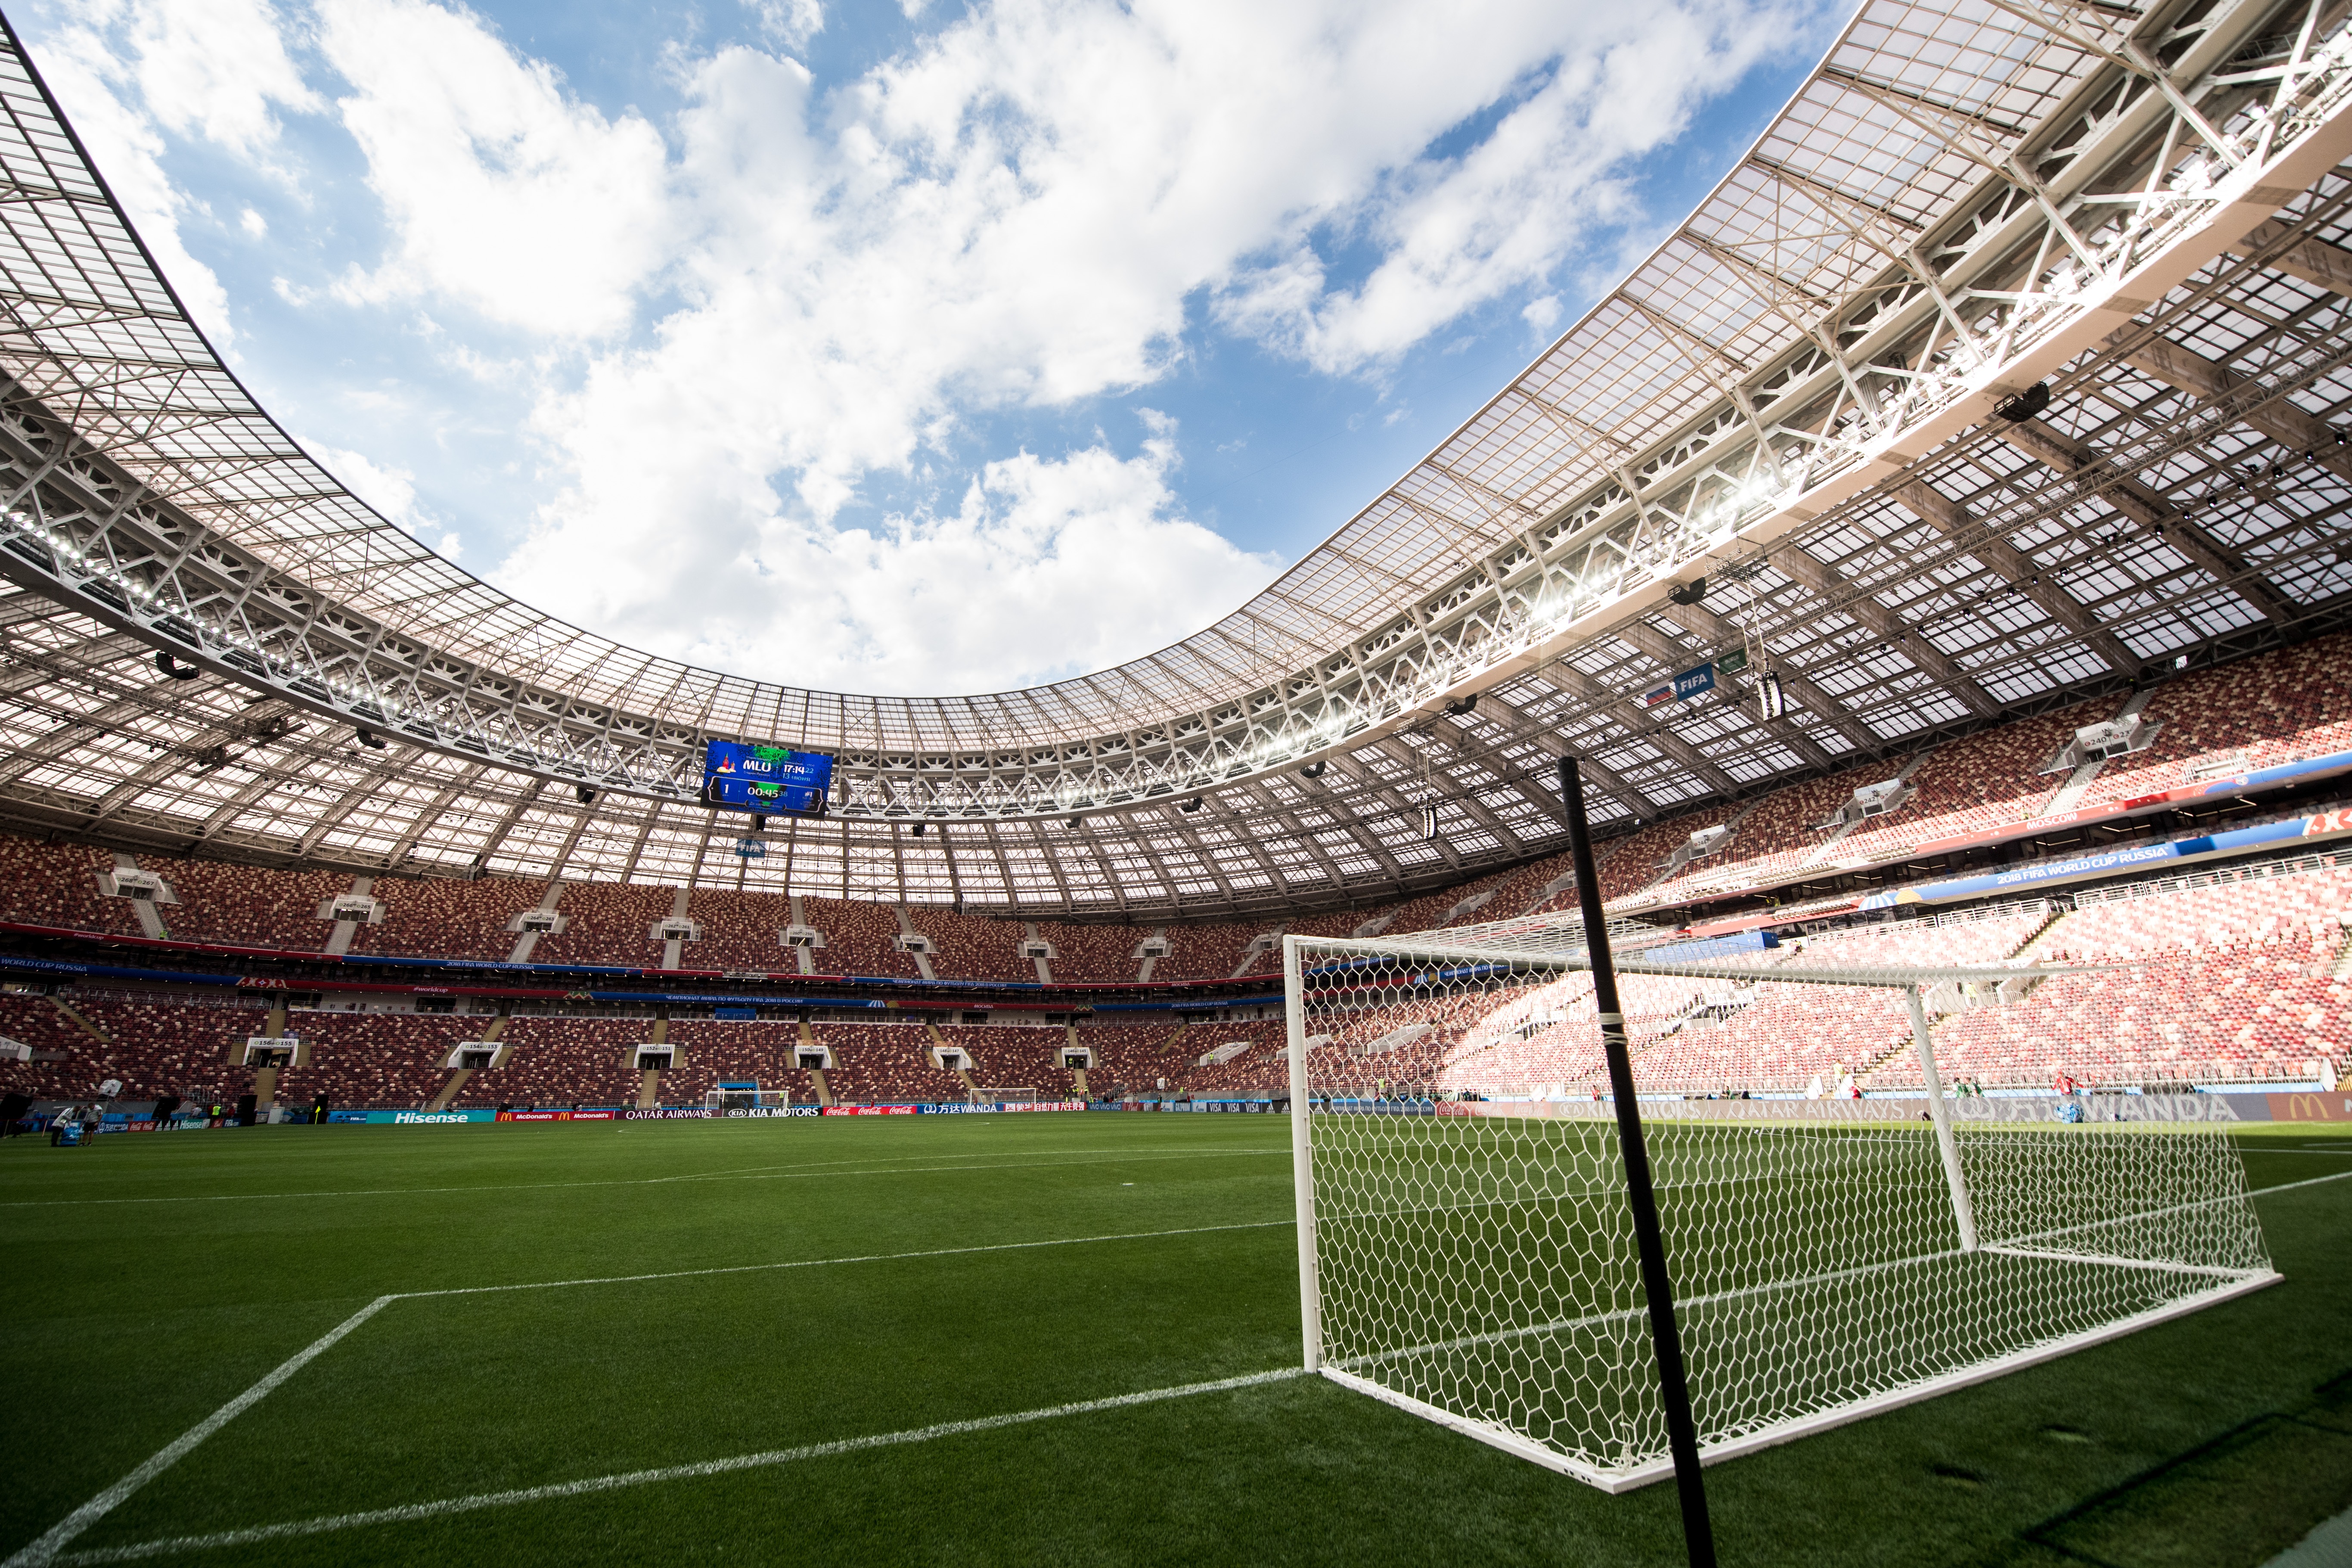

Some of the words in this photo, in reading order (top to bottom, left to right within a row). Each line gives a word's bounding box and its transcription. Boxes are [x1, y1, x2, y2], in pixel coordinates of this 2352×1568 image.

[1681, 674, 1707, 692] FIFA
[743, 760, 771, 772] MLU
[784, 765, 804, 774] 17:14
[748, 787, 778, 798] 00:45
[2026, 812, 2077, 829] MOSCOW
[740, 845, 760, 853] FIFA
[1997, 872, 2021, 884] 2018
[2023, 866, 2046, 880] FIFA
[2048, 861, 2090, 875] WORLD
[2091, 856, 2117, 867] CUP
[2119, 847, 2166, 863] RUSSIA
[1, 958, 34, 966] WORLD
[749, 1108, 768, 1117] KIA
[771, 1108, 818, 1117] MOTORS
[938, 1105, 960, 1114] 万达
[961, 1104, 997, 1113] WANDA
[1209, 1103, 1221, 1112] VISA
[1227, 1103, 1240, 1113] VISA
[1245, 1103, 1259, 1113] VISA
[1638, 1101, 1700, 1119] OTORS
[1730, 1101, 1798, 1120] QATAR
[1806, 1100, 1905, 1119] AIRWAYS
[2080, 1095, 2240, 1121] WANDA
[395, 1113, 469, 1124] Hisense
[626, 1111, 663, 1120] QATAR
[666, 1109, 712, 1118] AIRWAYS
[180, 1120, 202, 1130] Hisense
